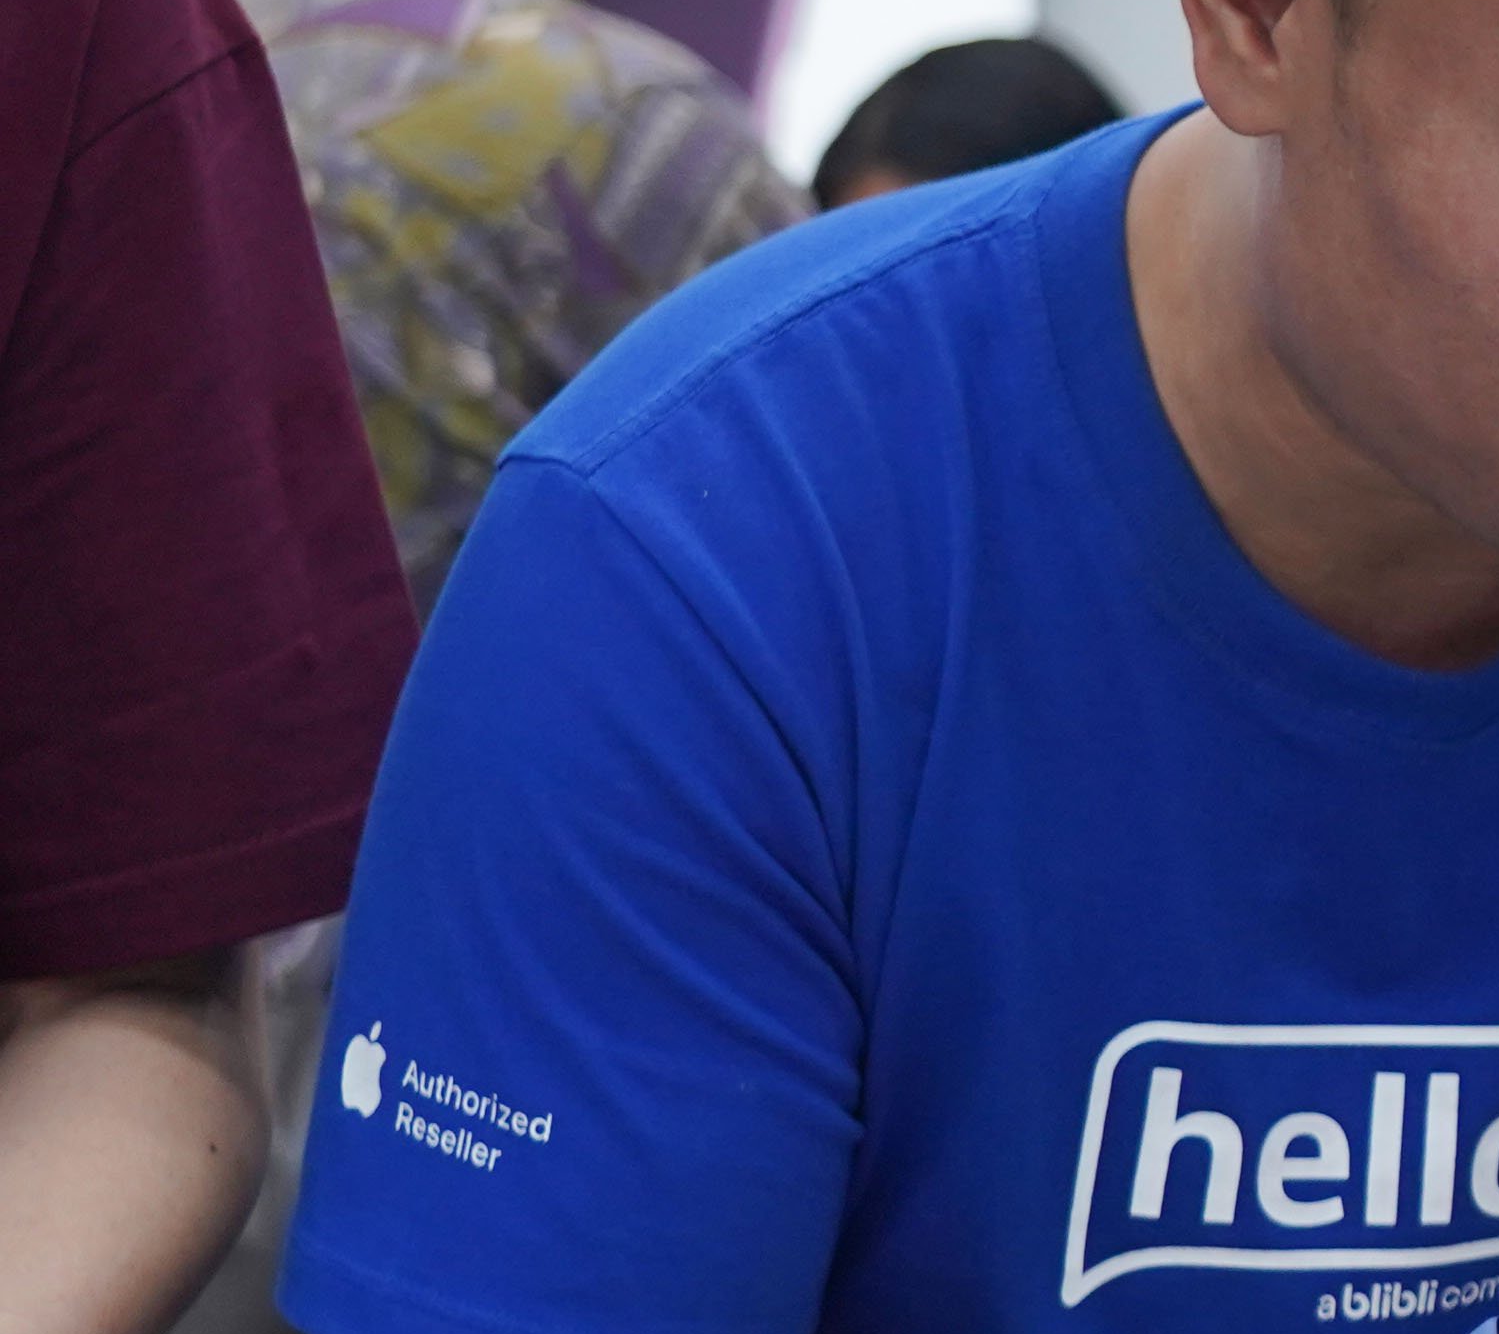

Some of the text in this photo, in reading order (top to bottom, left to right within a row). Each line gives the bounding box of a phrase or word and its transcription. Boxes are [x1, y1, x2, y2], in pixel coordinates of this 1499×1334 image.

[395, 1101, 502, 1172] Reseller
[402, 1059, 553, 1144] Authorized
[1317, 1293, 1337, 1321] a
[1342, 1280, 1439, 1320] blibli
